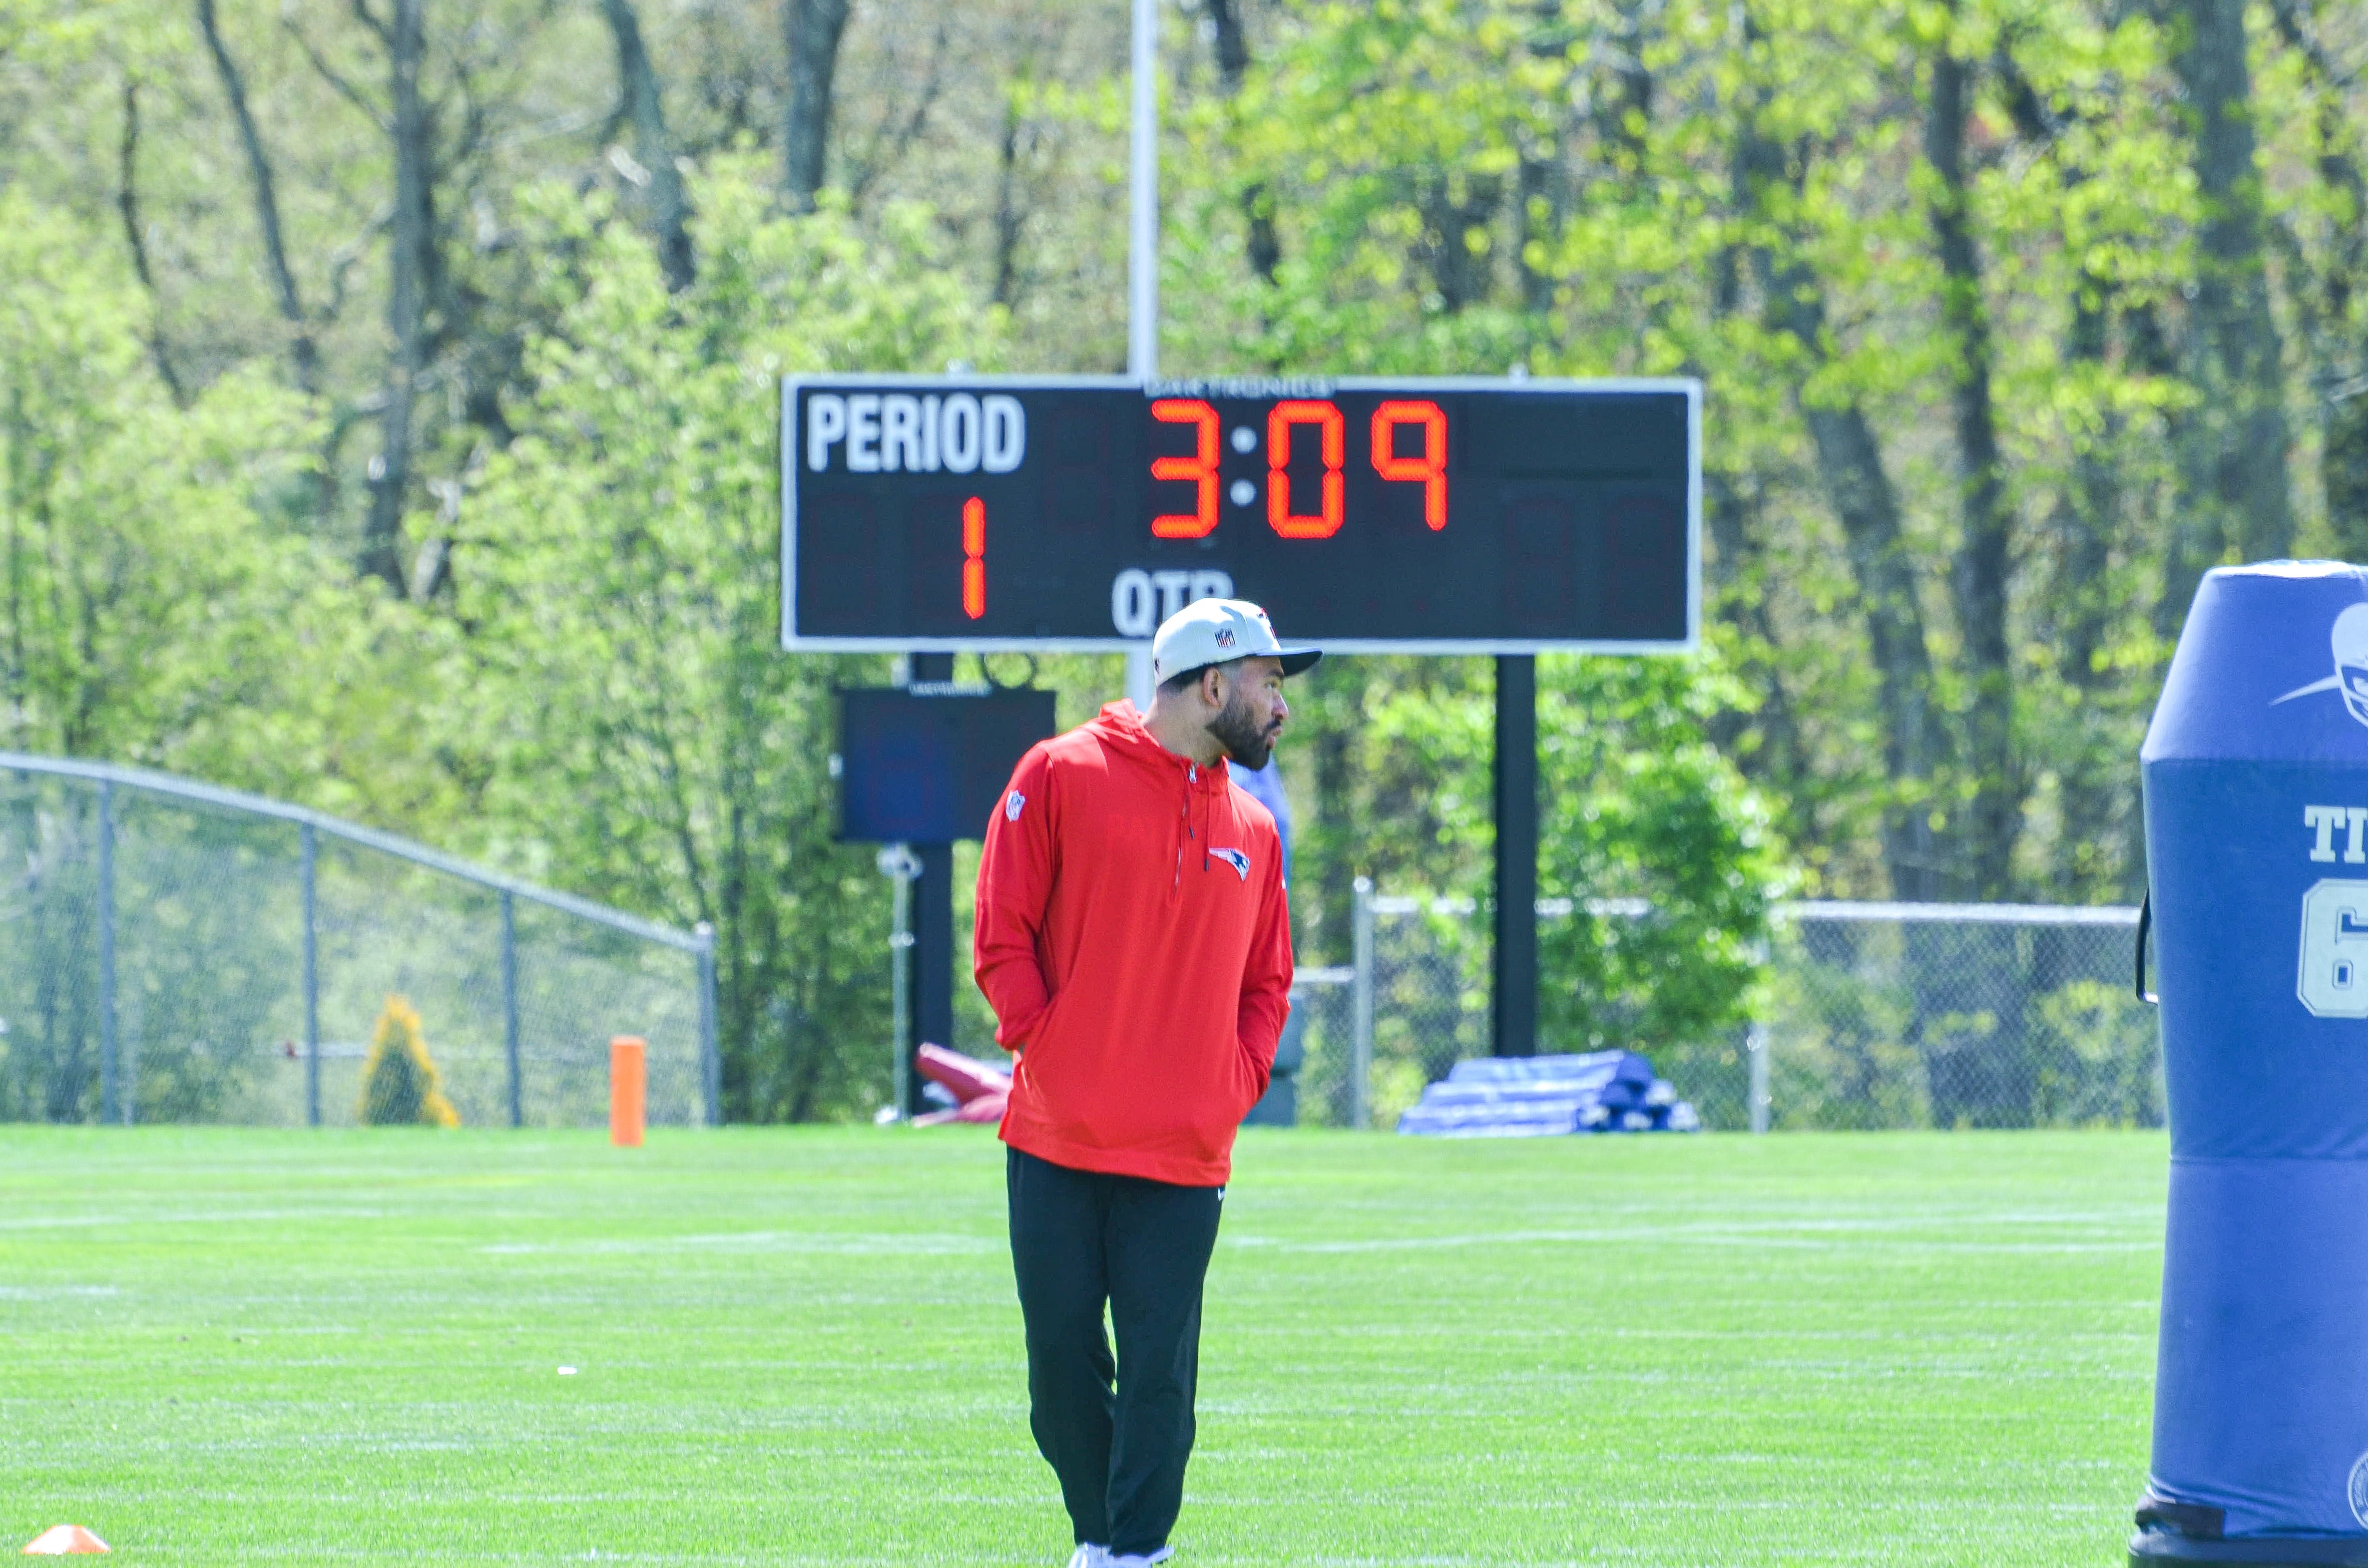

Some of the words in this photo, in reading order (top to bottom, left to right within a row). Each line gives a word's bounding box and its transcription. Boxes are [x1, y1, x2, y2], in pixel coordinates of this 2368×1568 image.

[807, 393, 1025, 472] PERIOD
[1151, 399, 1447, 539] 3:09
[962, 496, 986, 619] 1
[2305, 805, 2368, 864] TI
[2296, 877, 2368, 1019] 6
